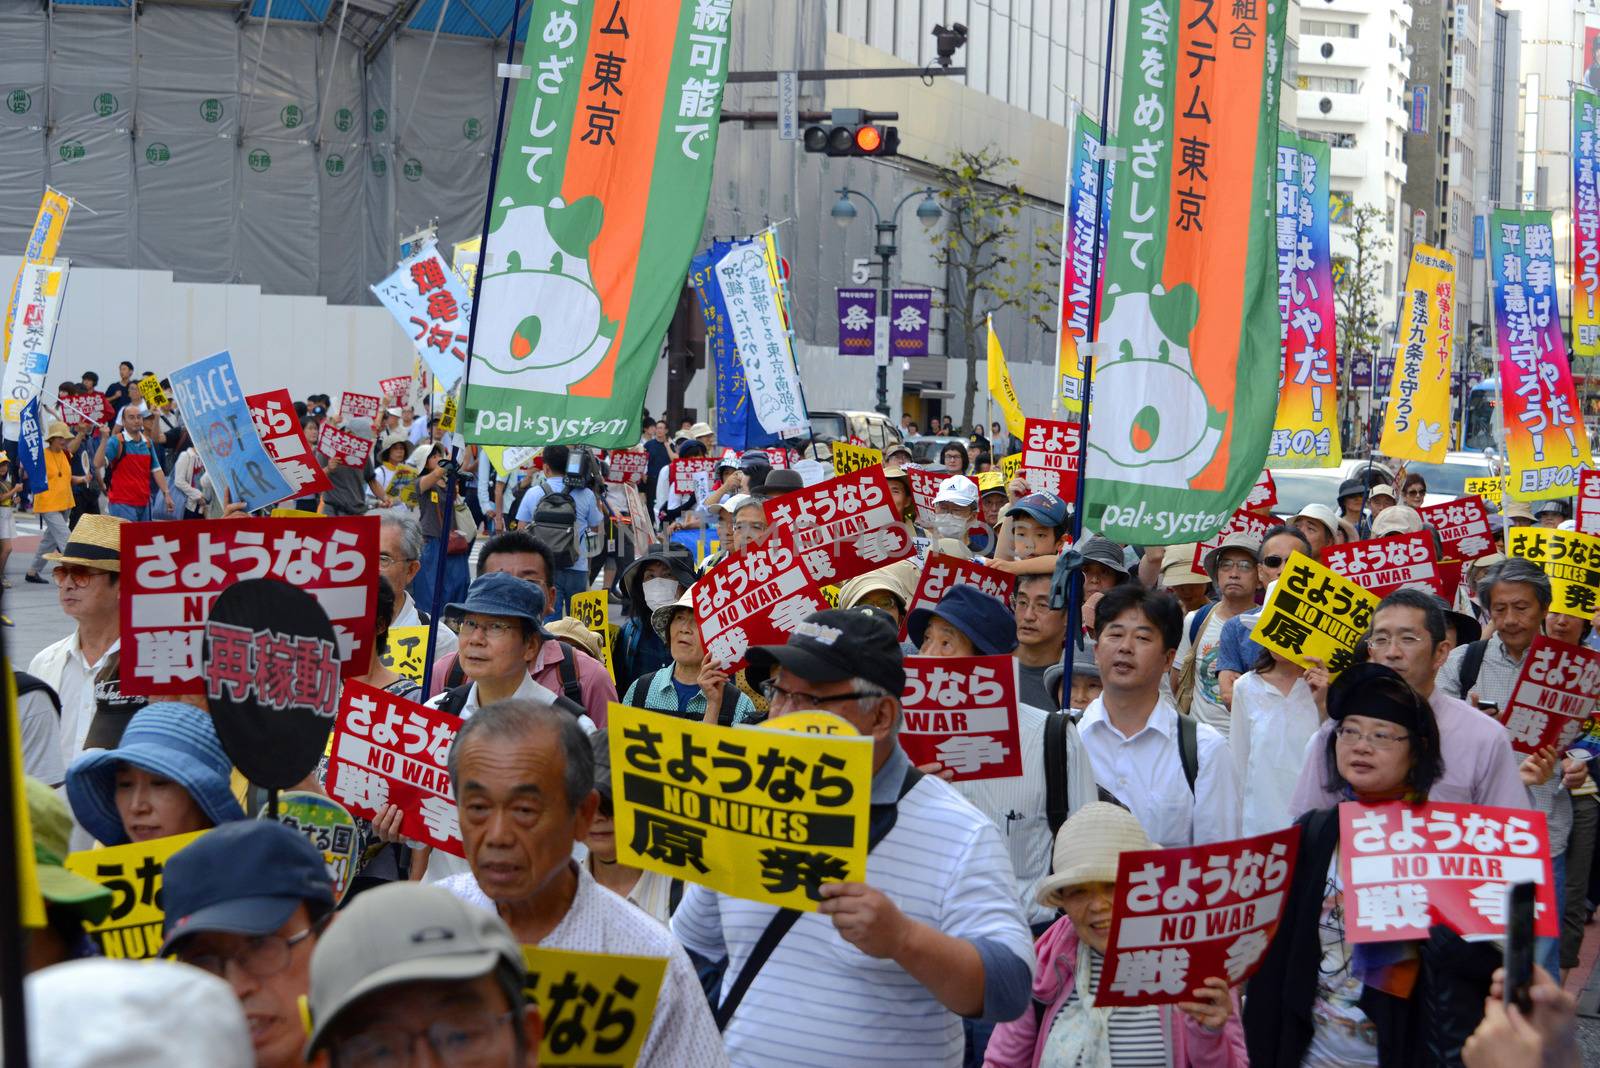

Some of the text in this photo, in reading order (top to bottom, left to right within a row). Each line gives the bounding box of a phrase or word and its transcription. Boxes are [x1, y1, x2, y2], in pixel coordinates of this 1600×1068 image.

[521, 0, 579, 184] めざして
[1123, 3, 1171, 270] 会をめざして
[852, 258, 870, 285] 5
[1395, 289, 1429, 433] 憲法九条を守ろう
[176, 364, 240, 421] PEACE
[771, 476, 884, 533] さようなら
[799, 515, 869, 551] NO WAR
[1328, 538, 1430, 575] さようなら
[1441, 527, 1469, 541] WAR
[135, 529, 367, 590] さようなら
[696, 539, 794, 619] さようなら
[1376, 567, 1412, 584] WAR
[717, 581, 783, 630] NO WAR
[1294, 601, 1316, 624] NO
[1565, 584, 1597, 613] 発
[1261, 611, 1312, 655] 原
[206, 622, 342, 718] 再稼動
[905, 711, 968, 732] WAR
[367, 747, 451, 794] NO WAR
[623, 723, 854, 808] さようなら
[936, 735, 1010, 773] 争
[334, 761, 390, 814] 戦
[663, 784, 809, 844] NO NUKES
[1352, 808, 1541, 855] さようなら
[630, 810, 711, 875] 原
[1126, 843, 1288, 912] さようなら
[1392, 855, 1503, 879] NO WAR
[1159, 904, 1257, 942] NO WAR
[1357, 883, 1431, 931] 戦
[1110, 948, 1190, 997] 戦
